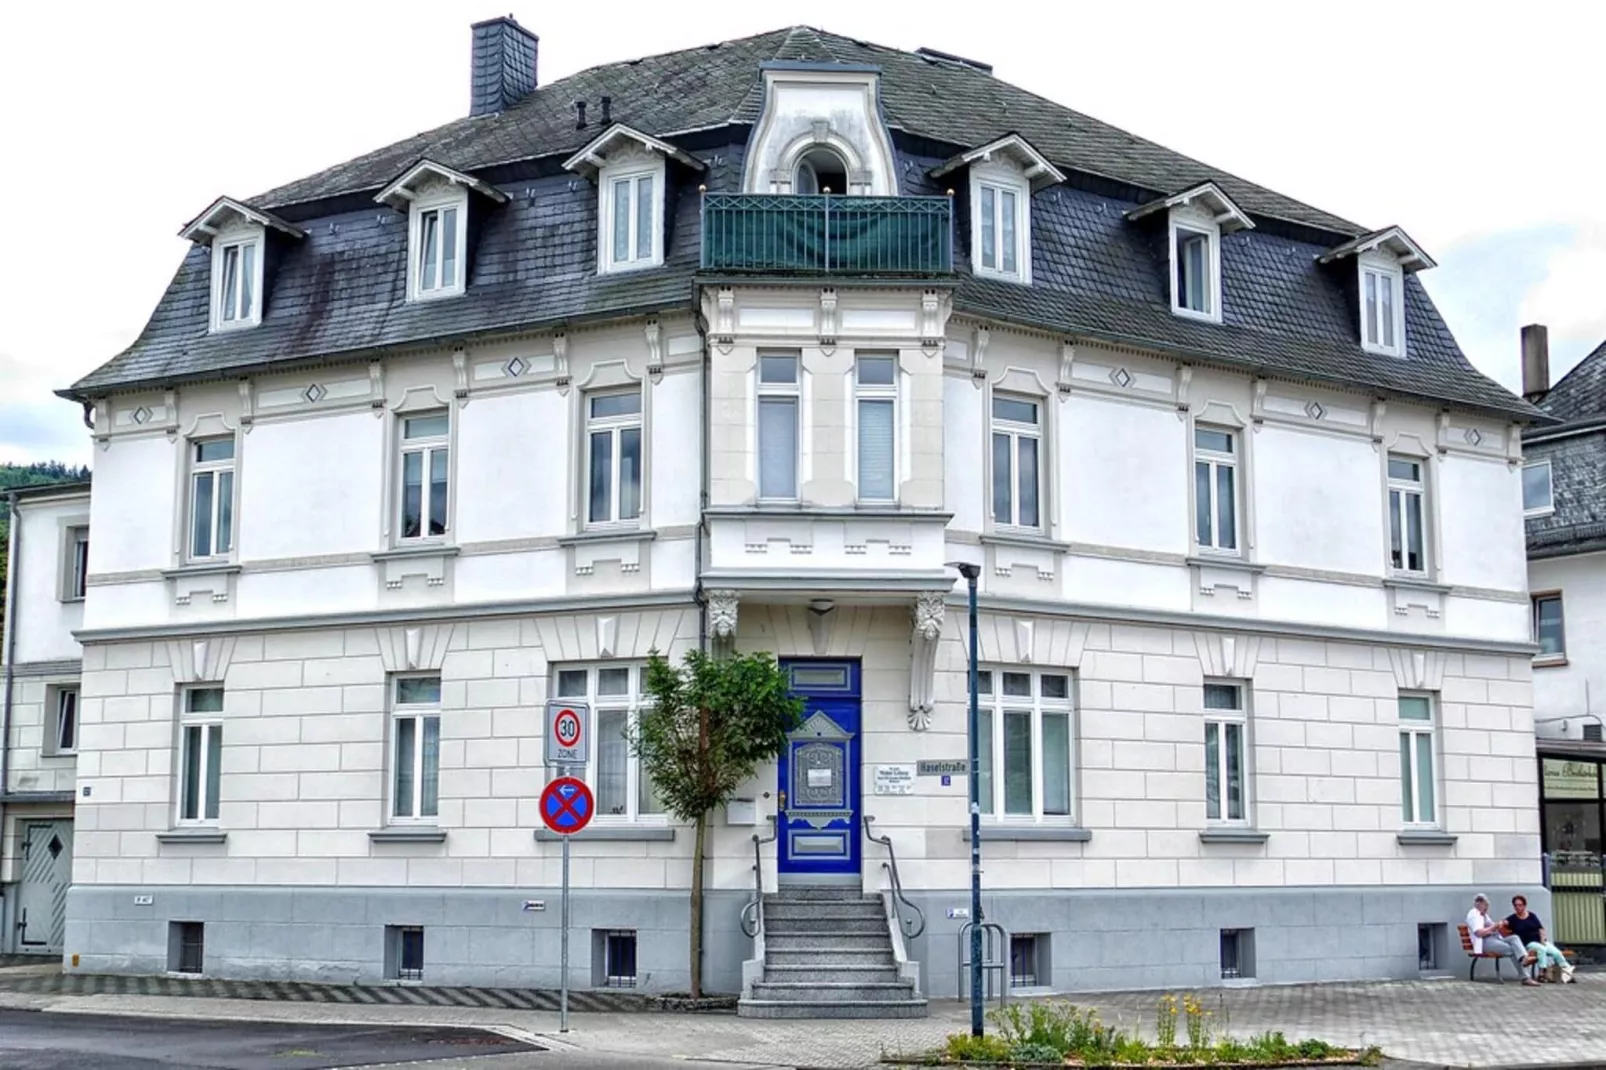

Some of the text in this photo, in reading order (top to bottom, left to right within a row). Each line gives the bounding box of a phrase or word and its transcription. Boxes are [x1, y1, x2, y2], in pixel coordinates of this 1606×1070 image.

[560, 719, 575, 737] 30
[557, 749, 578, 759] ZONE
[920, 761, 966, 773] Haselstraße
